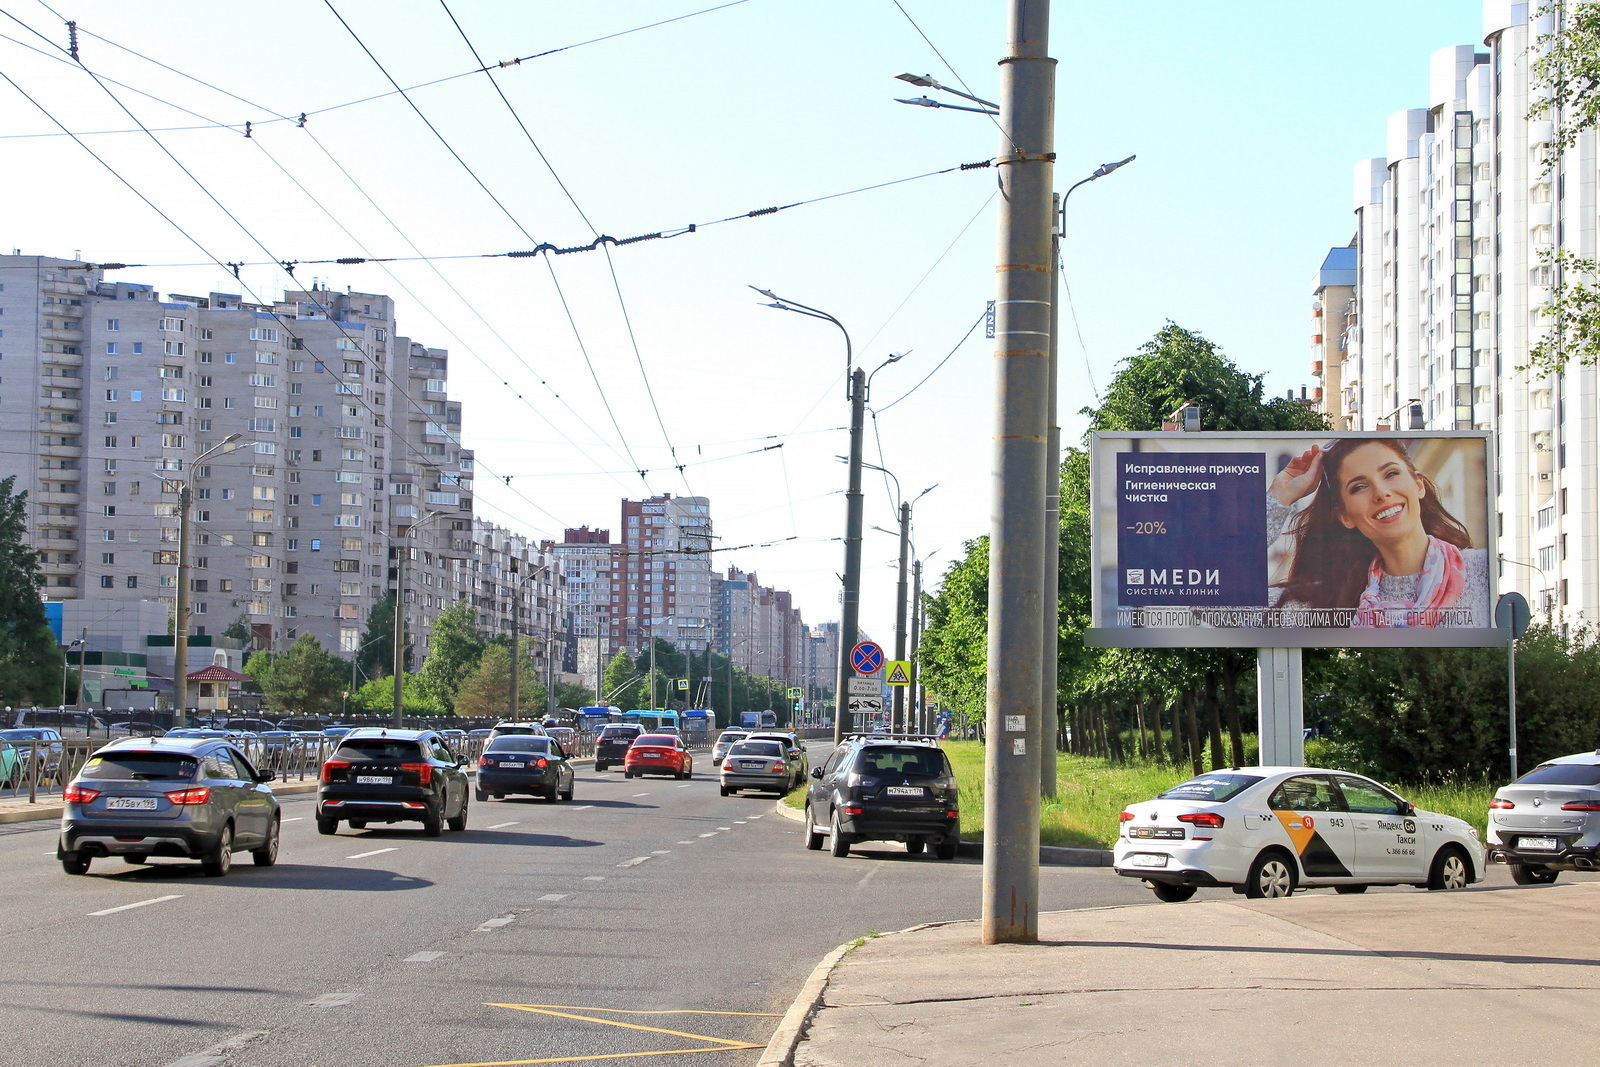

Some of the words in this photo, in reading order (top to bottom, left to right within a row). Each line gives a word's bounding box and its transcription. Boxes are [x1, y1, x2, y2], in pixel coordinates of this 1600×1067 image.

[1125, 463, 1206, 476] Исправление
[1209, 464, 1260, 476] прикуса
[1125, 480, 1216, 490] Гигиеническая
[1125, 493, 1168, 502] чистка
[1126, 522, 1167, 534] -20%
[1126, 588, 1174, 596] СИСТЕМА
[1180, 588, 1220, 596] КЛИНИК
[1117, 612, 1162, 626] ИМЕЮТСЯ
[1165, 611, 1265, 628] ПРОТИВОПОКАЗАНИЯ,
[1268, 611, 1330, 628] НЕОБХОДИМА
[1333, 611, 1404, 628] КОНСУЛЬТАЦИЯ
[1406, 611, 1474, 627] СПЕЦИАЛИСТА
[1330, 818, 1344, 827] 943
[1378, 820, 1403, 831] Яндекс
[1404, 821, 1415, 832] Go
[1396, 834, 1415, 844] Такси
